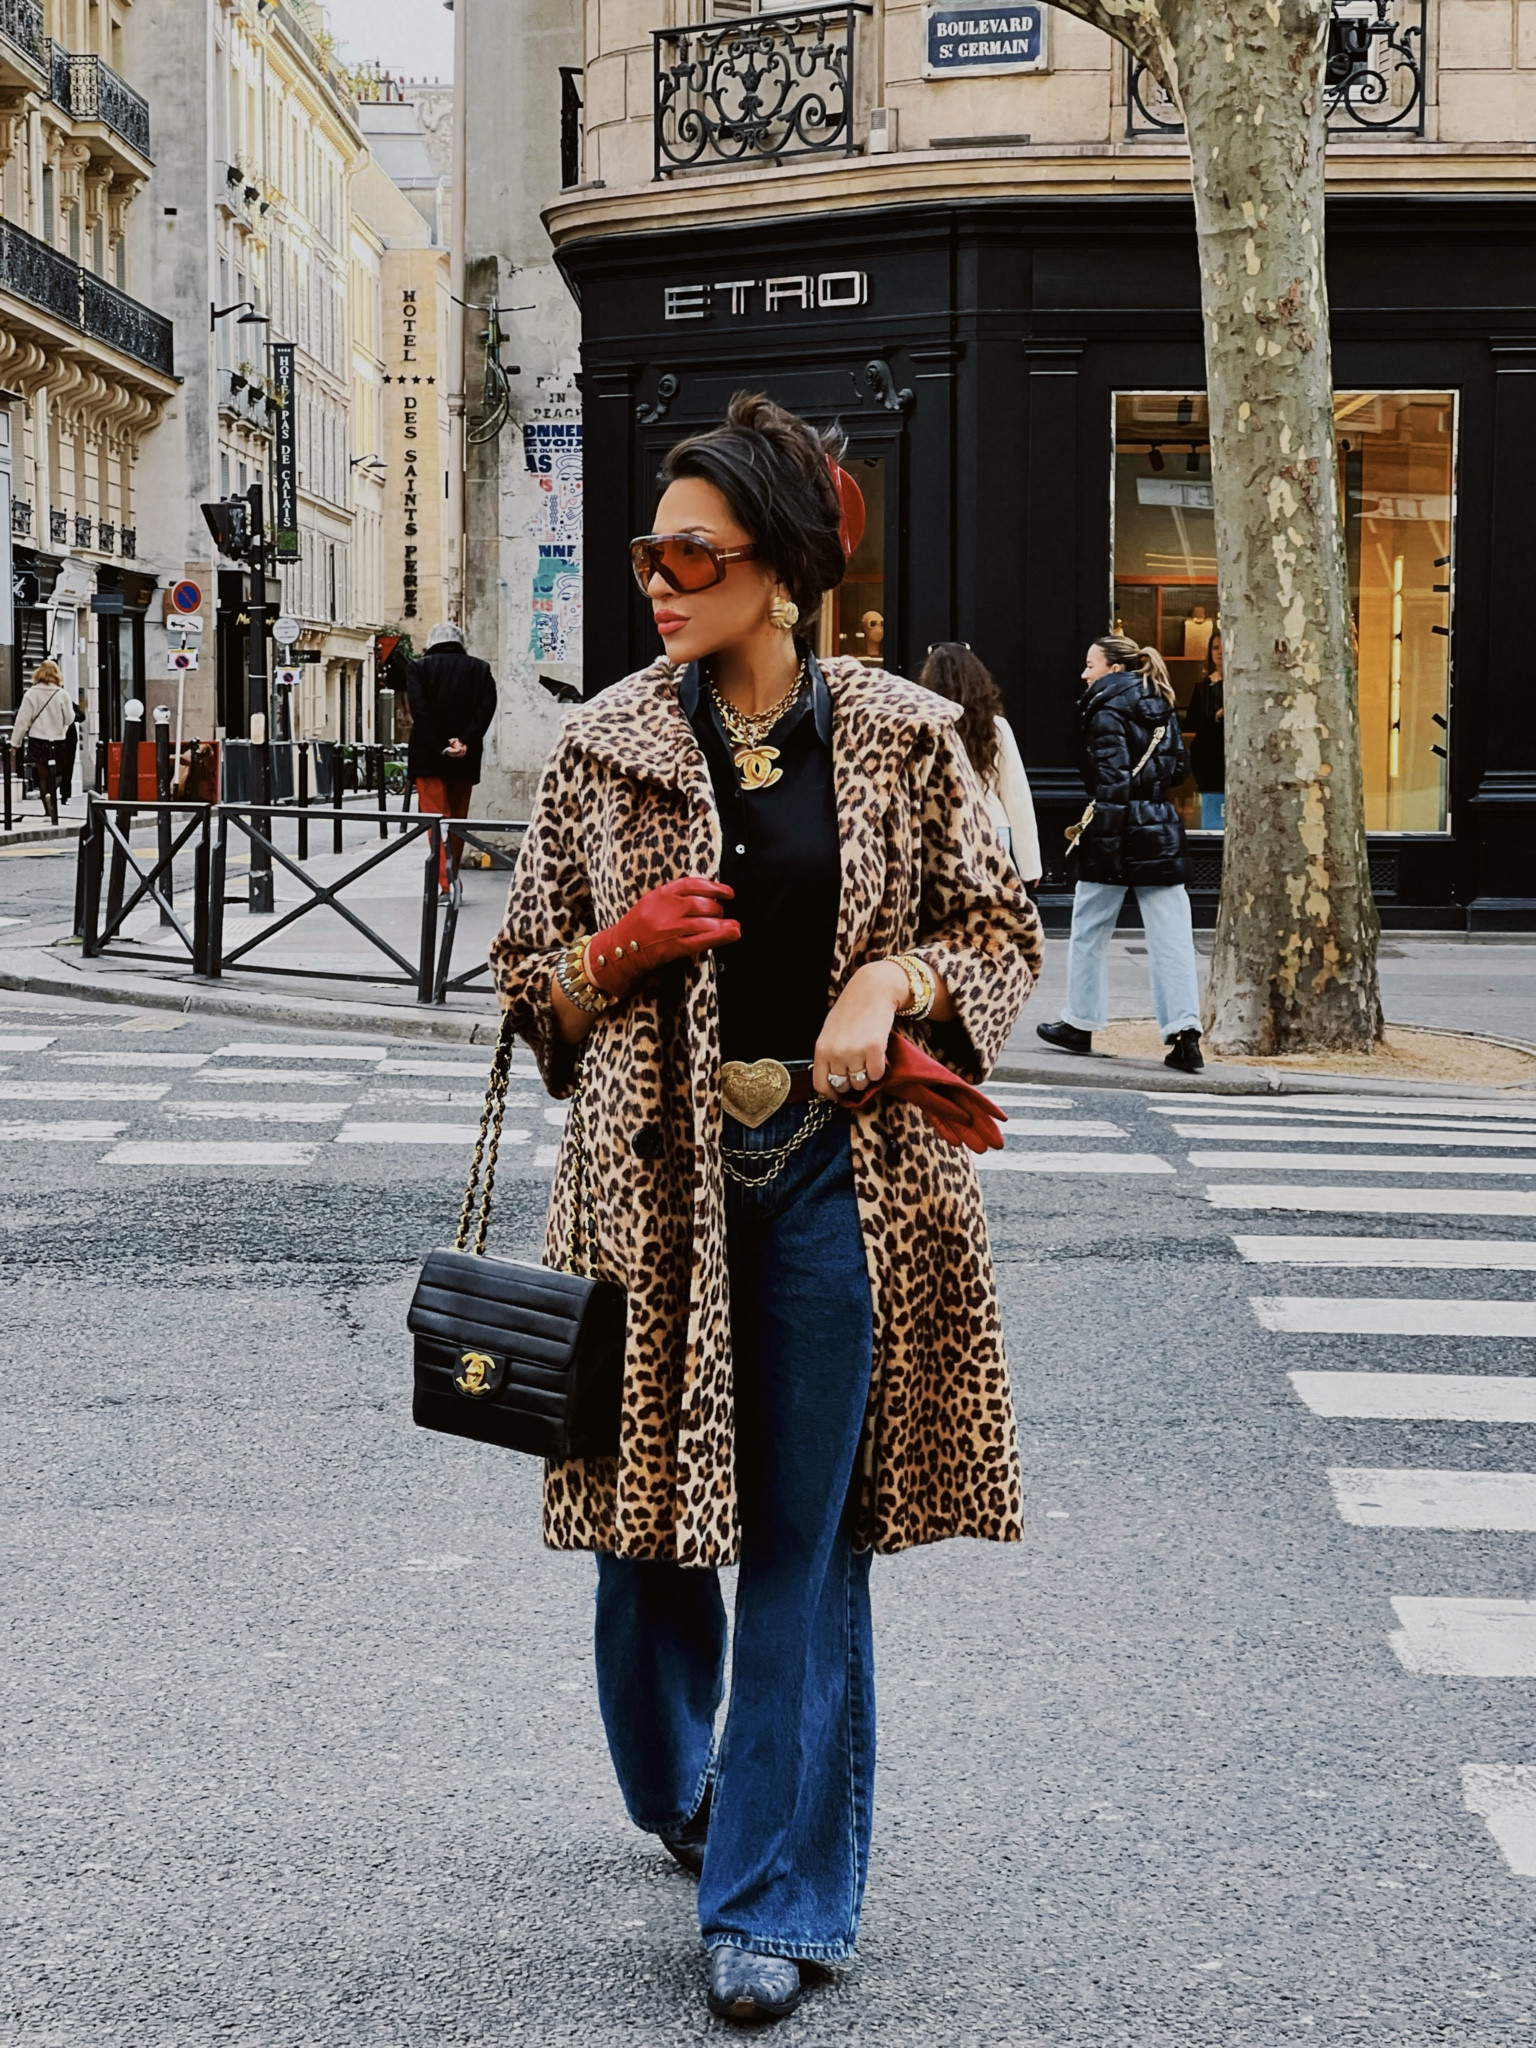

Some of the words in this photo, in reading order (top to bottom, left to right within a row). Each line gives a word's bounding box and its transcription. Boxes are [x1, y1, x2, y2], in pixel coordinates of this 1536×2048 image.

[937, 17, 1033, 37] BOULEVARD
[958, 39, 1029, 57] GERMAIN
[664, 271, 867, 320] ETRO
[402, 290, 417, 362] HOTEL
[404, 397, 418, 439] DES
[549, 393, 566, 403] IN
[281, 410, 290, 439] PAS
[281, 445, 291, 465] DE
[281, 470, 292, 528] CALAIS
[404, 450, 418, 536] SAINTS
[403, 545, 418, 618] PERES
